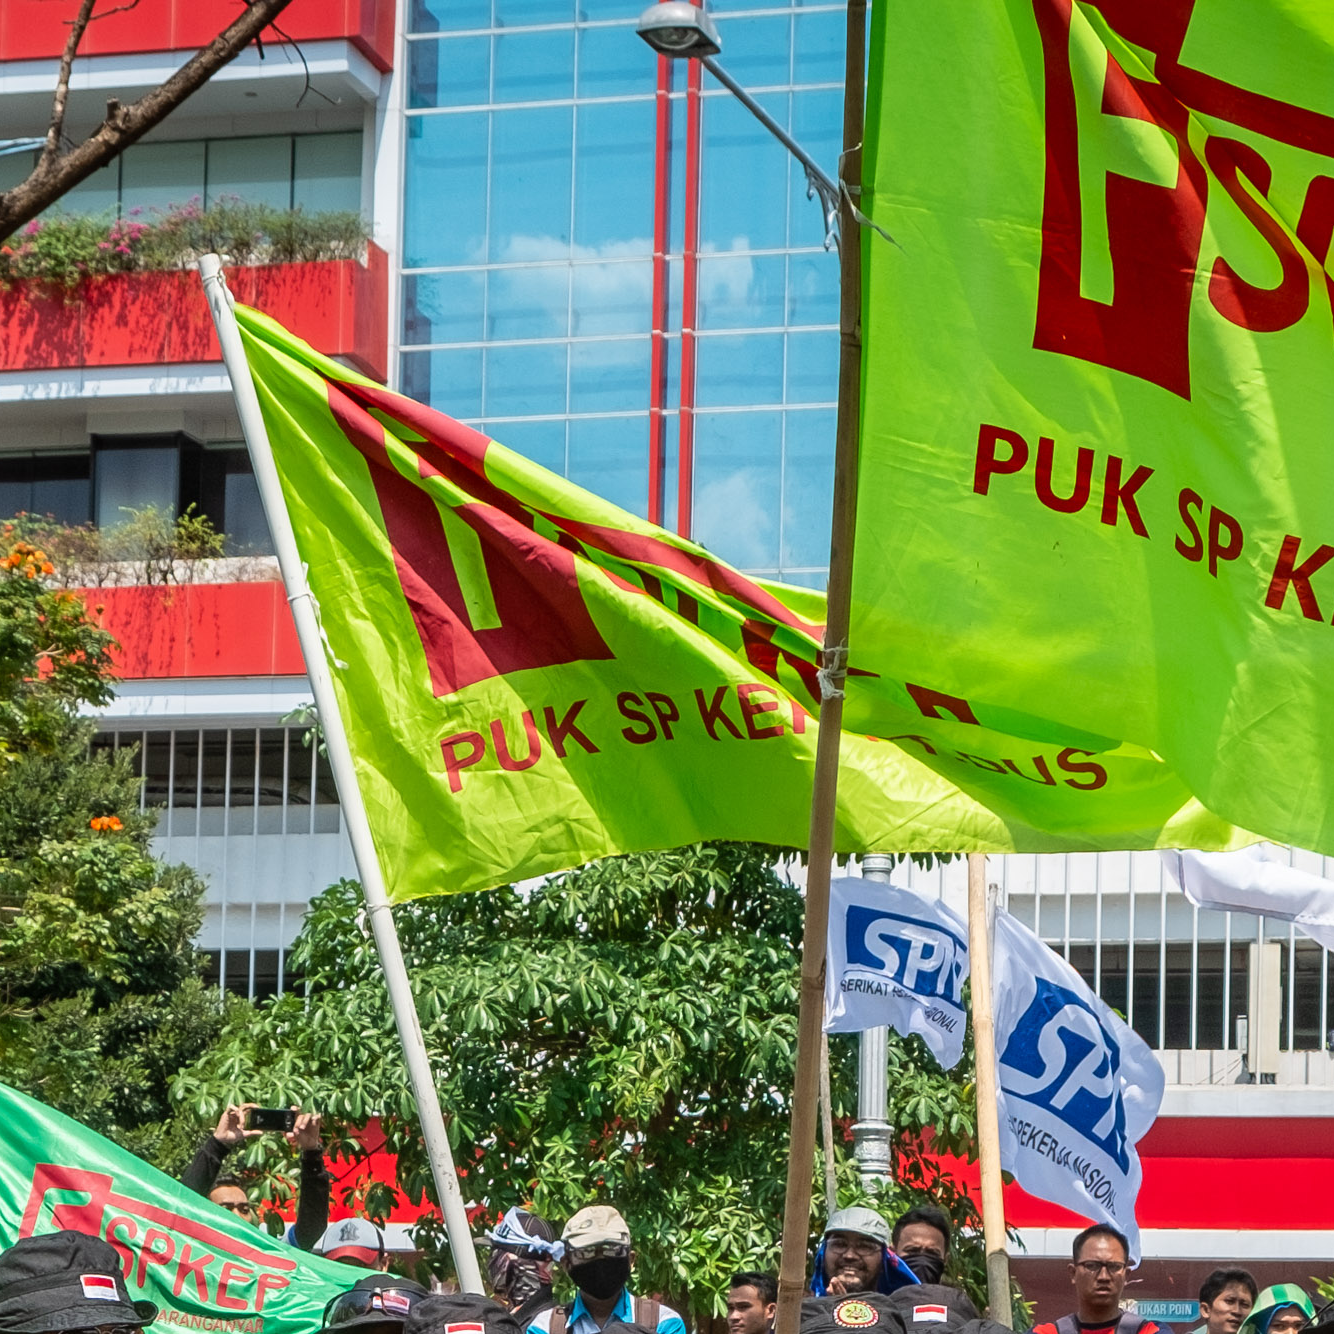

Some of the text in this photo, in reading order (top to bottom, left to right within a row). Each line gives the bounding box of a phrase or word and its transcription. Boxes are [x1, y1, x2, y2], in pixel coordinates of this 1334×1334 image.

[972, 422, 1153, 540] PUK
[1174, 487, 1244, 579] SP
[438, 698, 599, 794] PUK
[618, 689, 680, 745] SP
[841, 978, 890, 997] SERIKAT
[105, 1216, 291, 1312] SPKEP
[156, 1309, 265, 1334] ARANGANYAR
[1168, 1303, 1193, 1316] POIN
